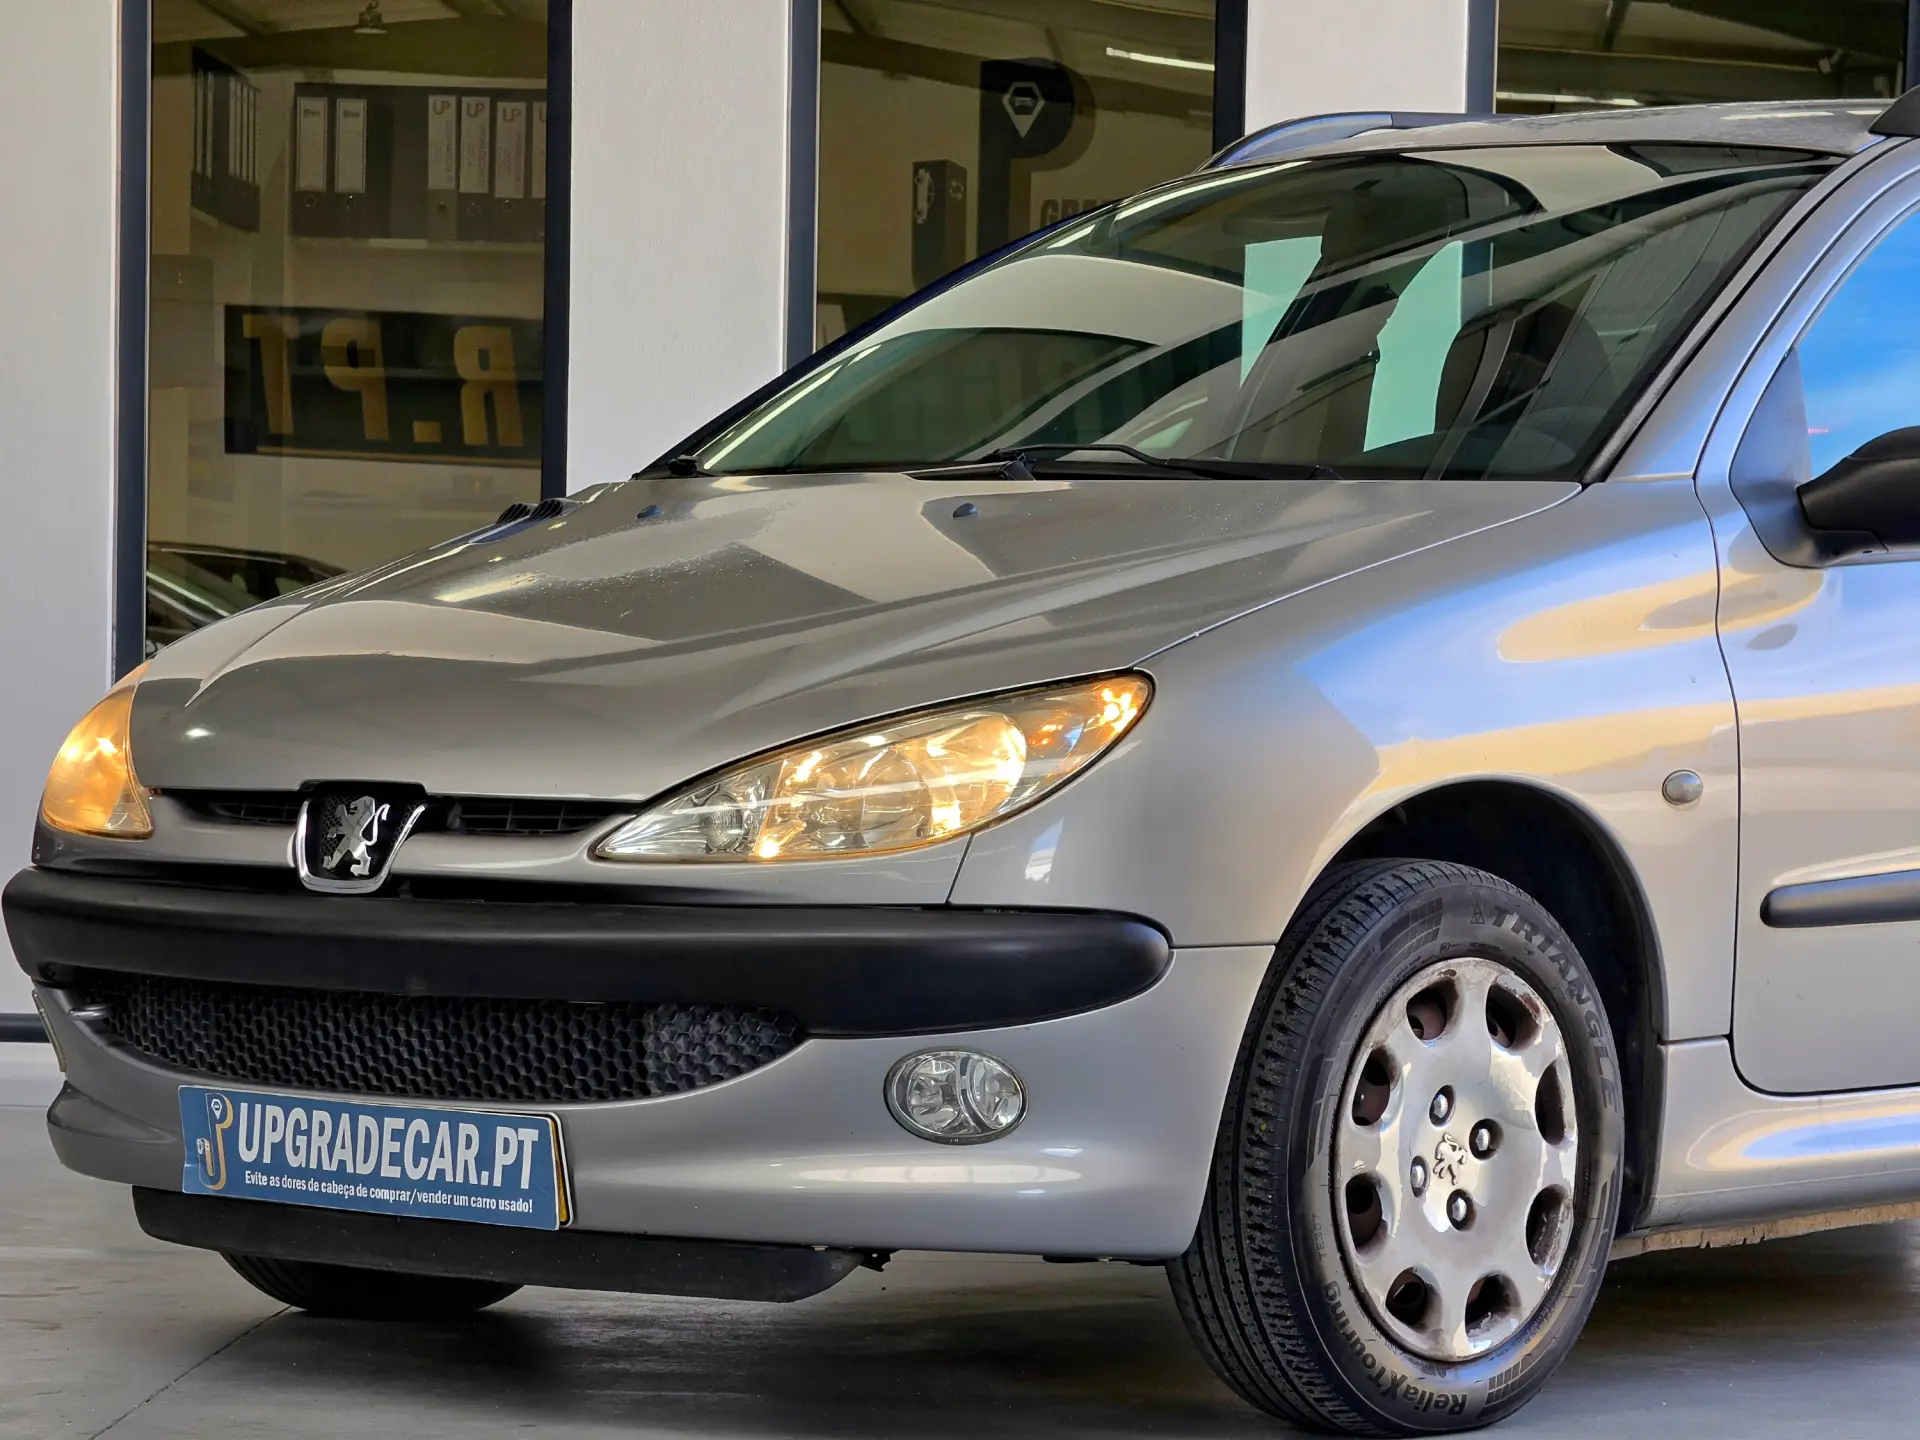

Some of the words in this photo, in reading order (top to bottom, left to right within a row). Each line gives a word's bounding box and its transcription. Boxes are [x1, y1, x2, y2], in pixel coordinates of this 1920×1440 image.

[1493, 906, 1618, 1113] TRIANGLE
[238, 1102, 539, 1190] UPGRADECAR.PT
[245, 1170, 268, 1186] Evite
[269, 1175, 280, 1188] as
[281, 1174, 307, 1191] dores
[307, 1177, 320, 1192] de
[321, 1180, 355, 1199] cabeça
[356, 1183, 368, 1198] de
[369, 1187, 452, 1205] comprar/vender
[453, 1194, 469, 1208] um
[470, 1196, 497, 1210] carro
[498, 1198, 533, 1214] usado!
